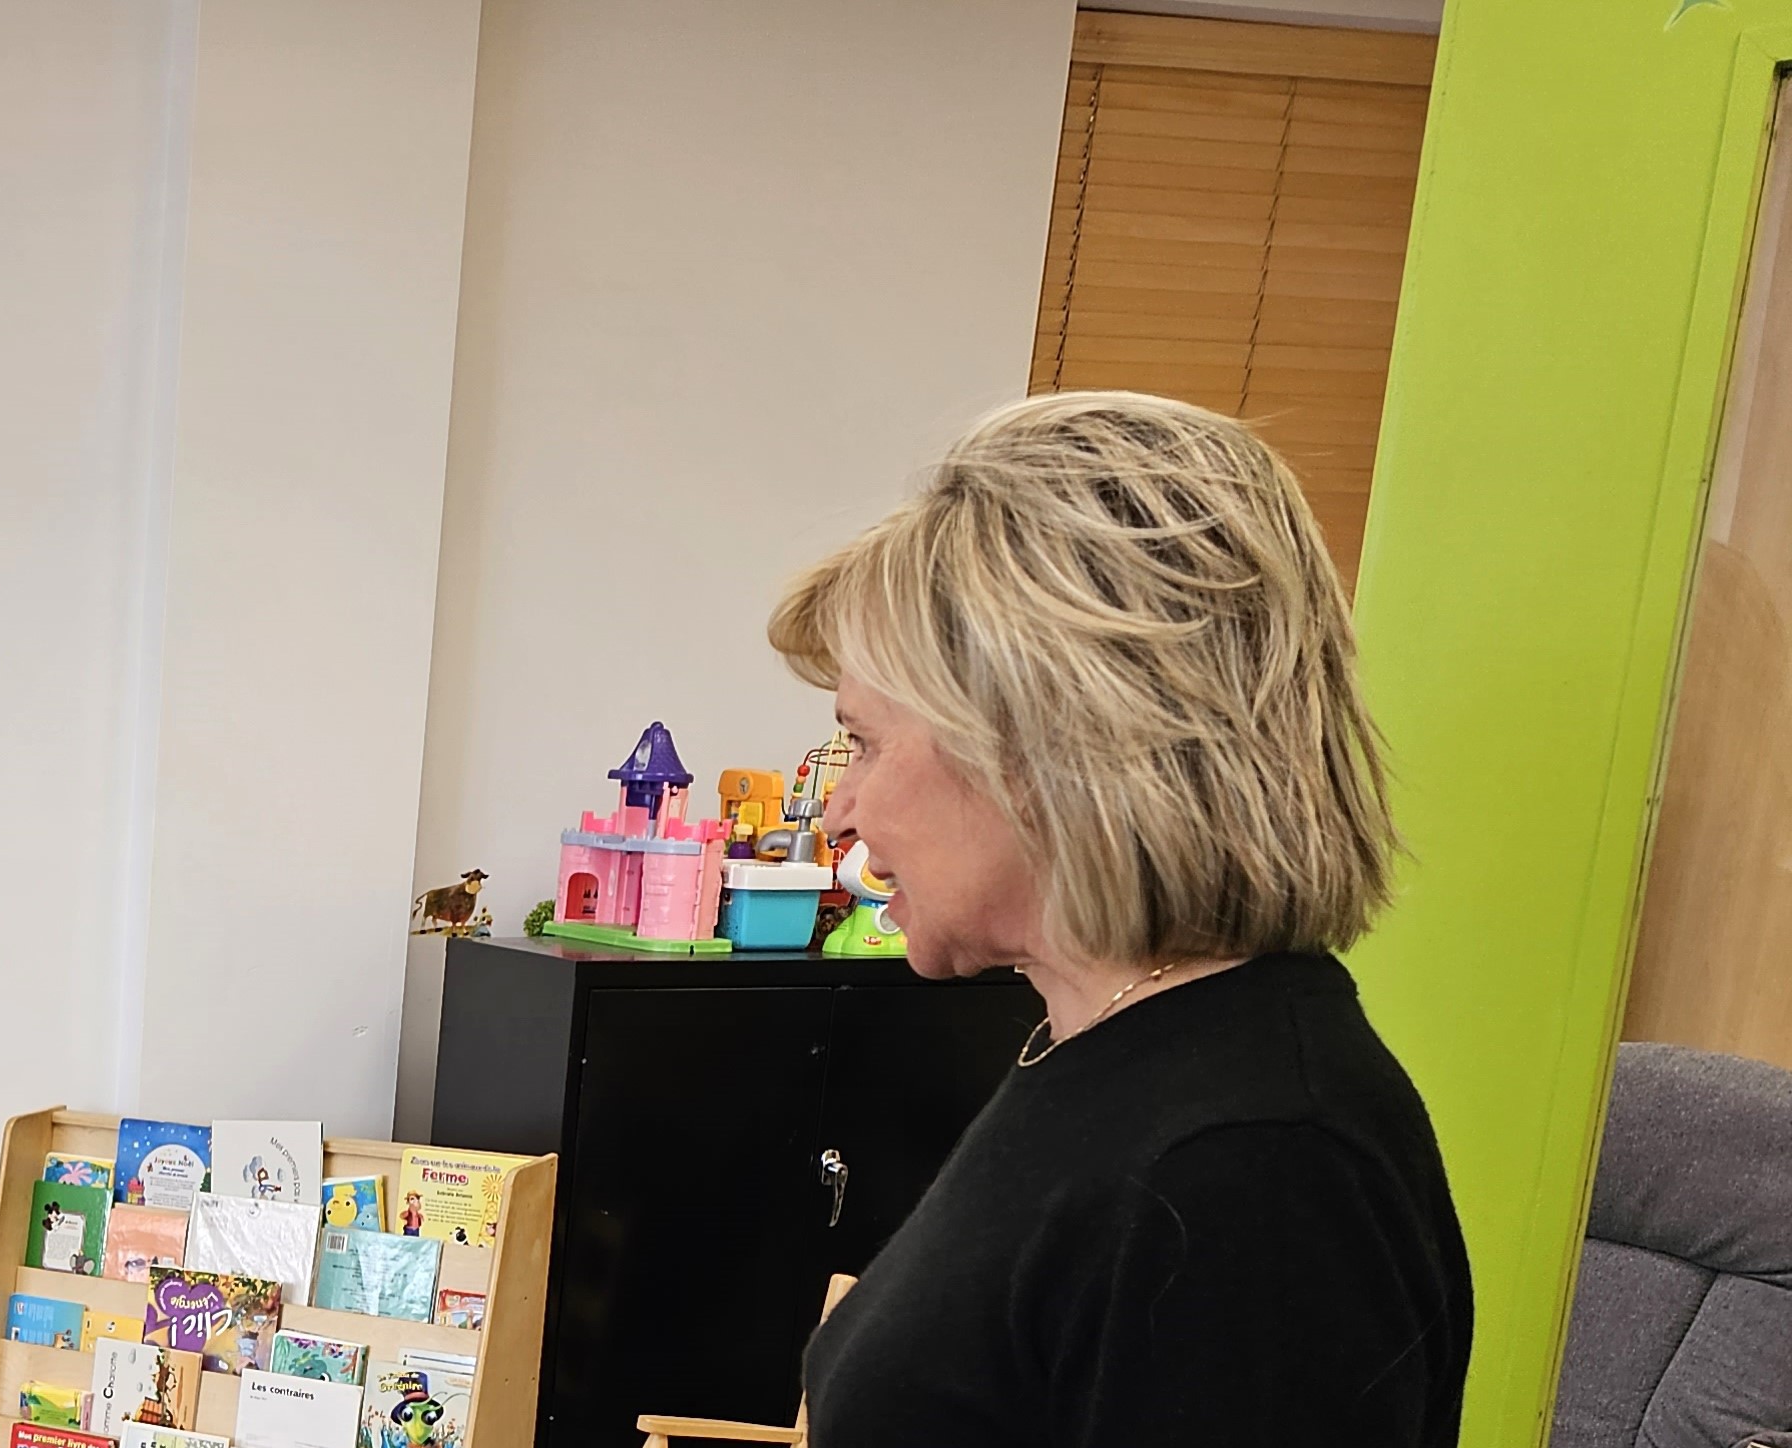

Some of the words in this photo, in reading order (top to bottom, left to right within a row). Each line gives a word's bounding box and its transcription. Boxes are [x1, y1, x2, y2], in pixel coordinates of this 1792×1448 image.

[422, 1168, 468, 1185] Ferme
[251, 1382, 267, 1392] Les
[270, 1385, 315, 1400] contraires
[33, 1433, 67, 1447] premier
